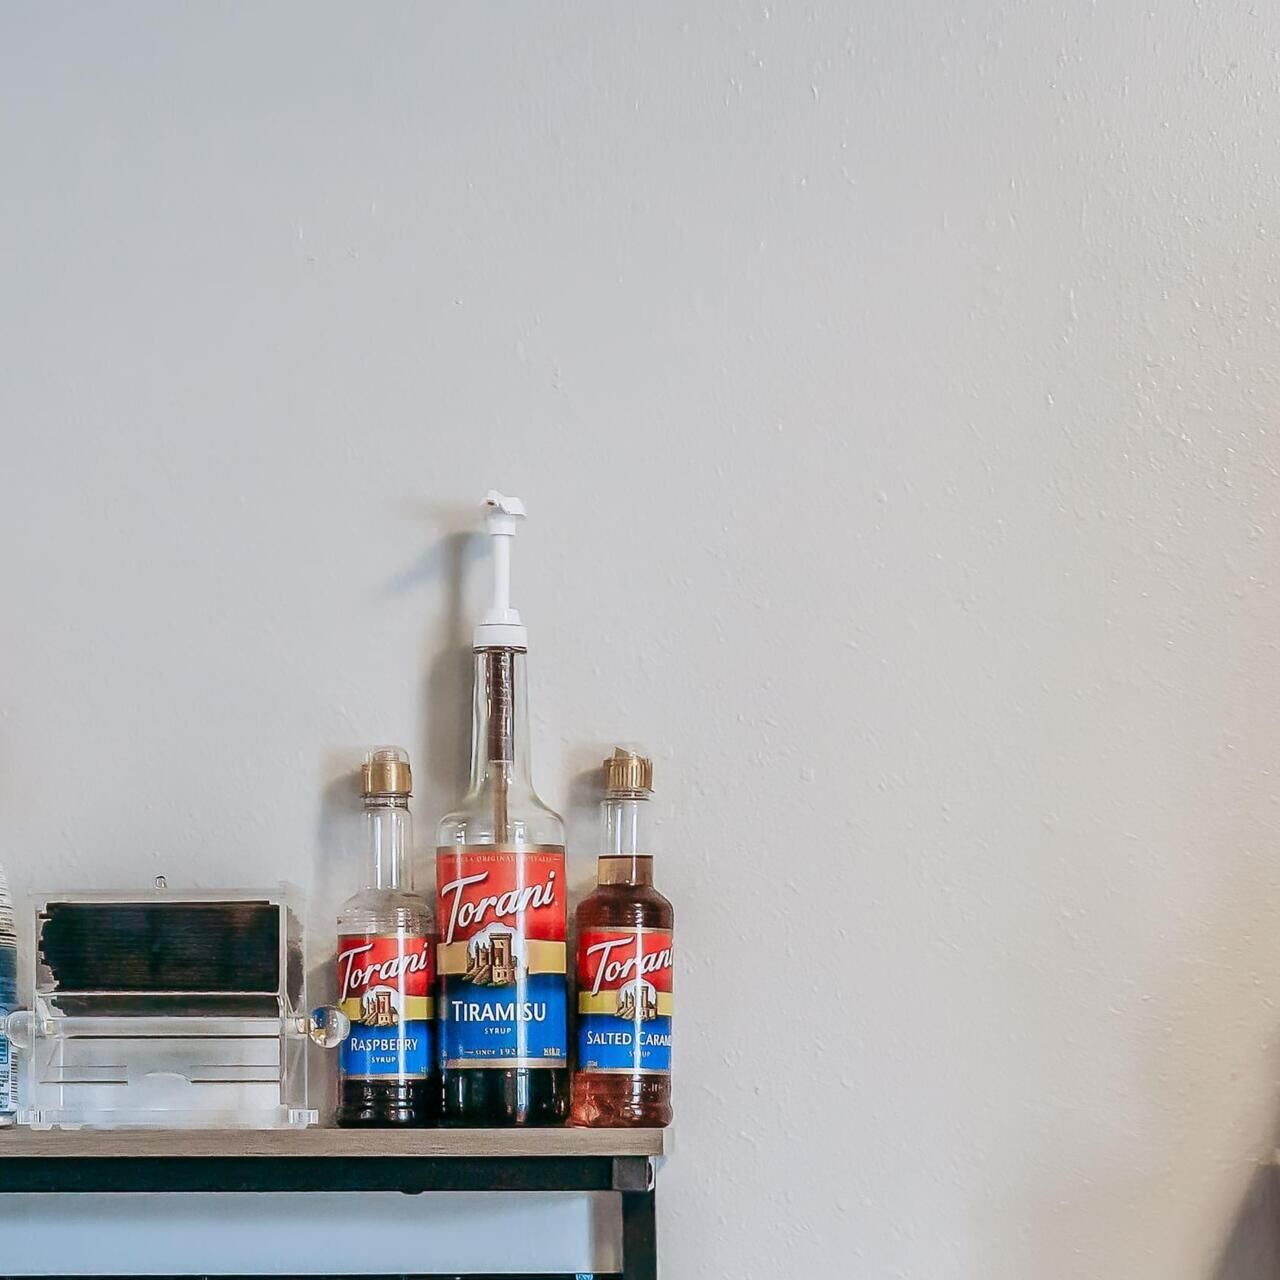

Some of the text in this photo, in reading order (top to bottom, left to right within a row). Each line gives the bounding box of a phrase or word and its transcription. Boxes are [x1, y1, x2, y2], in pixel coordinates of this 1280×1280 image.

[441, 870, 556, 947] Torani
[338, 942, 428, 1005] Torani
[483, 1027, 512, 1035] SYRUP
[586, 1030, 632, 1046] SALTED
[351, 1037, 418, 1051] RASPBERRY
[371, 1056, 396, 1064] SYRUP
